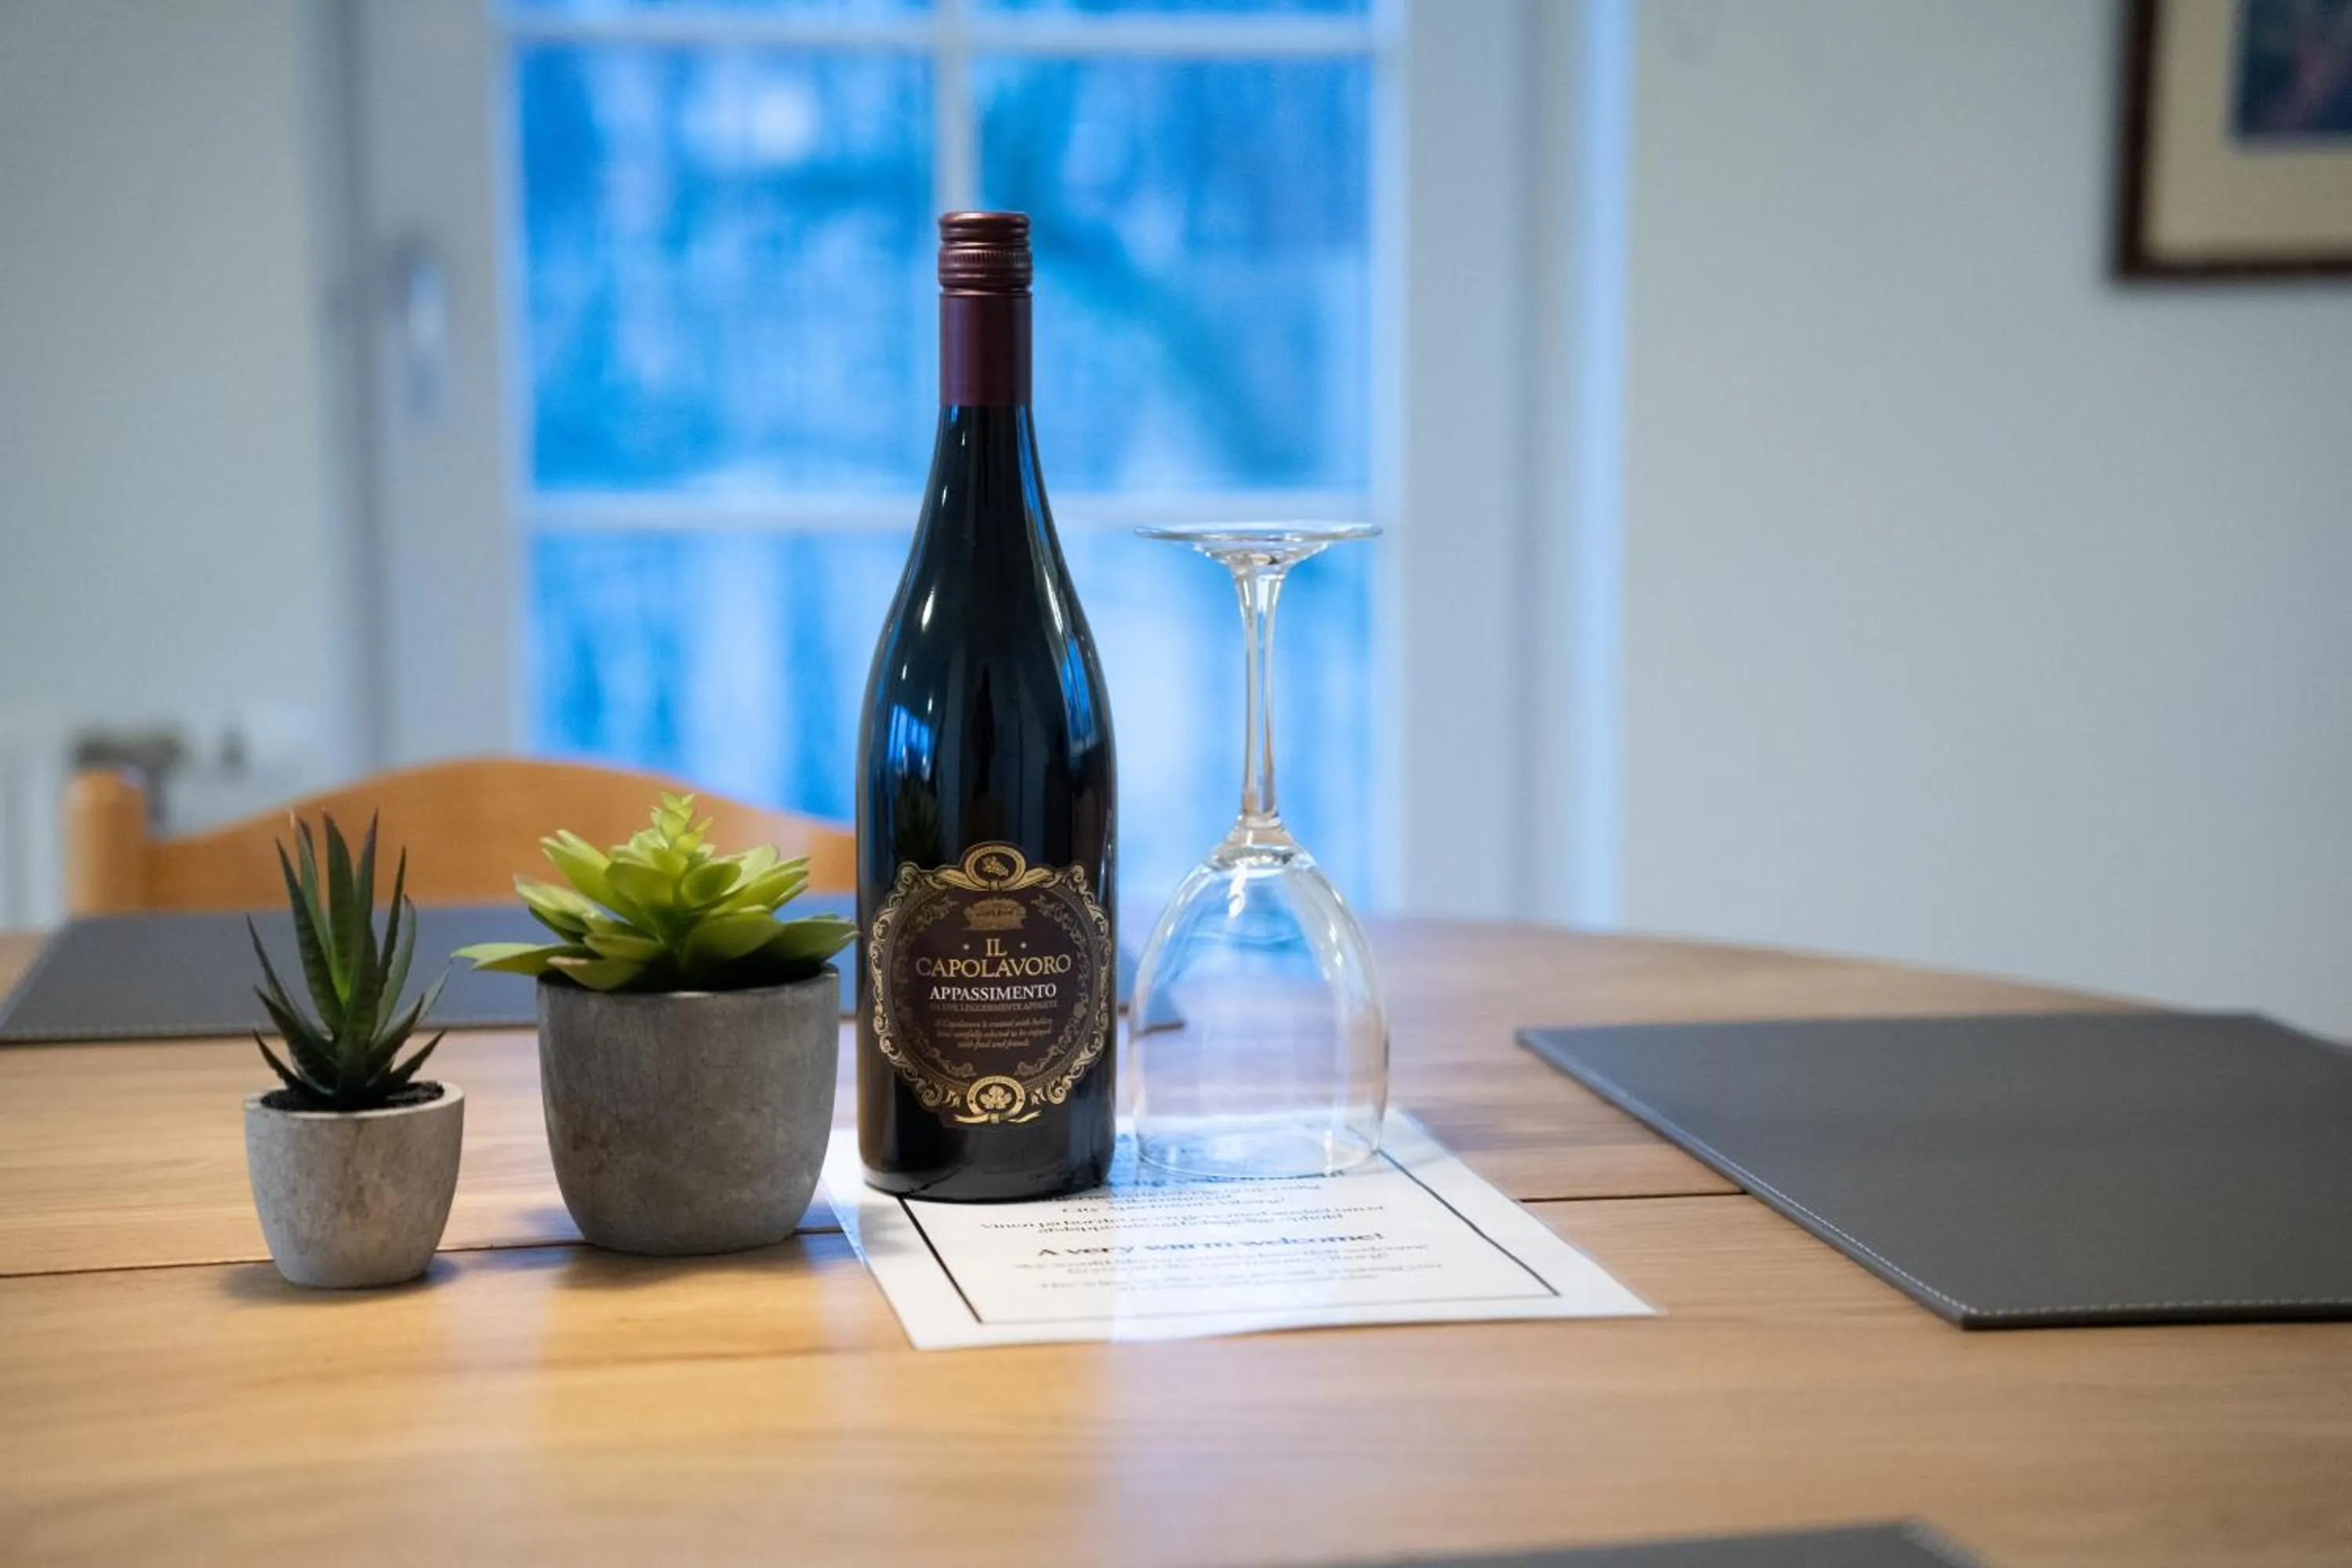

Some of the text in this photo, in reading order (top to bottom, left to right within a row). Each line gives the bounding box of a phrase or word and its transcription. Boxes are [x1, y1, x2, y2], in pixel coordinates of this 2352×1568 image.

[985, 938, 1008, 957] IL
[915, 954, 1072, 978] CAPOLAVORO
[929, 982, 1057, 1001] APPASSIMENTO
[1036, 1231, 1386, 1257] A very warm welcome!
